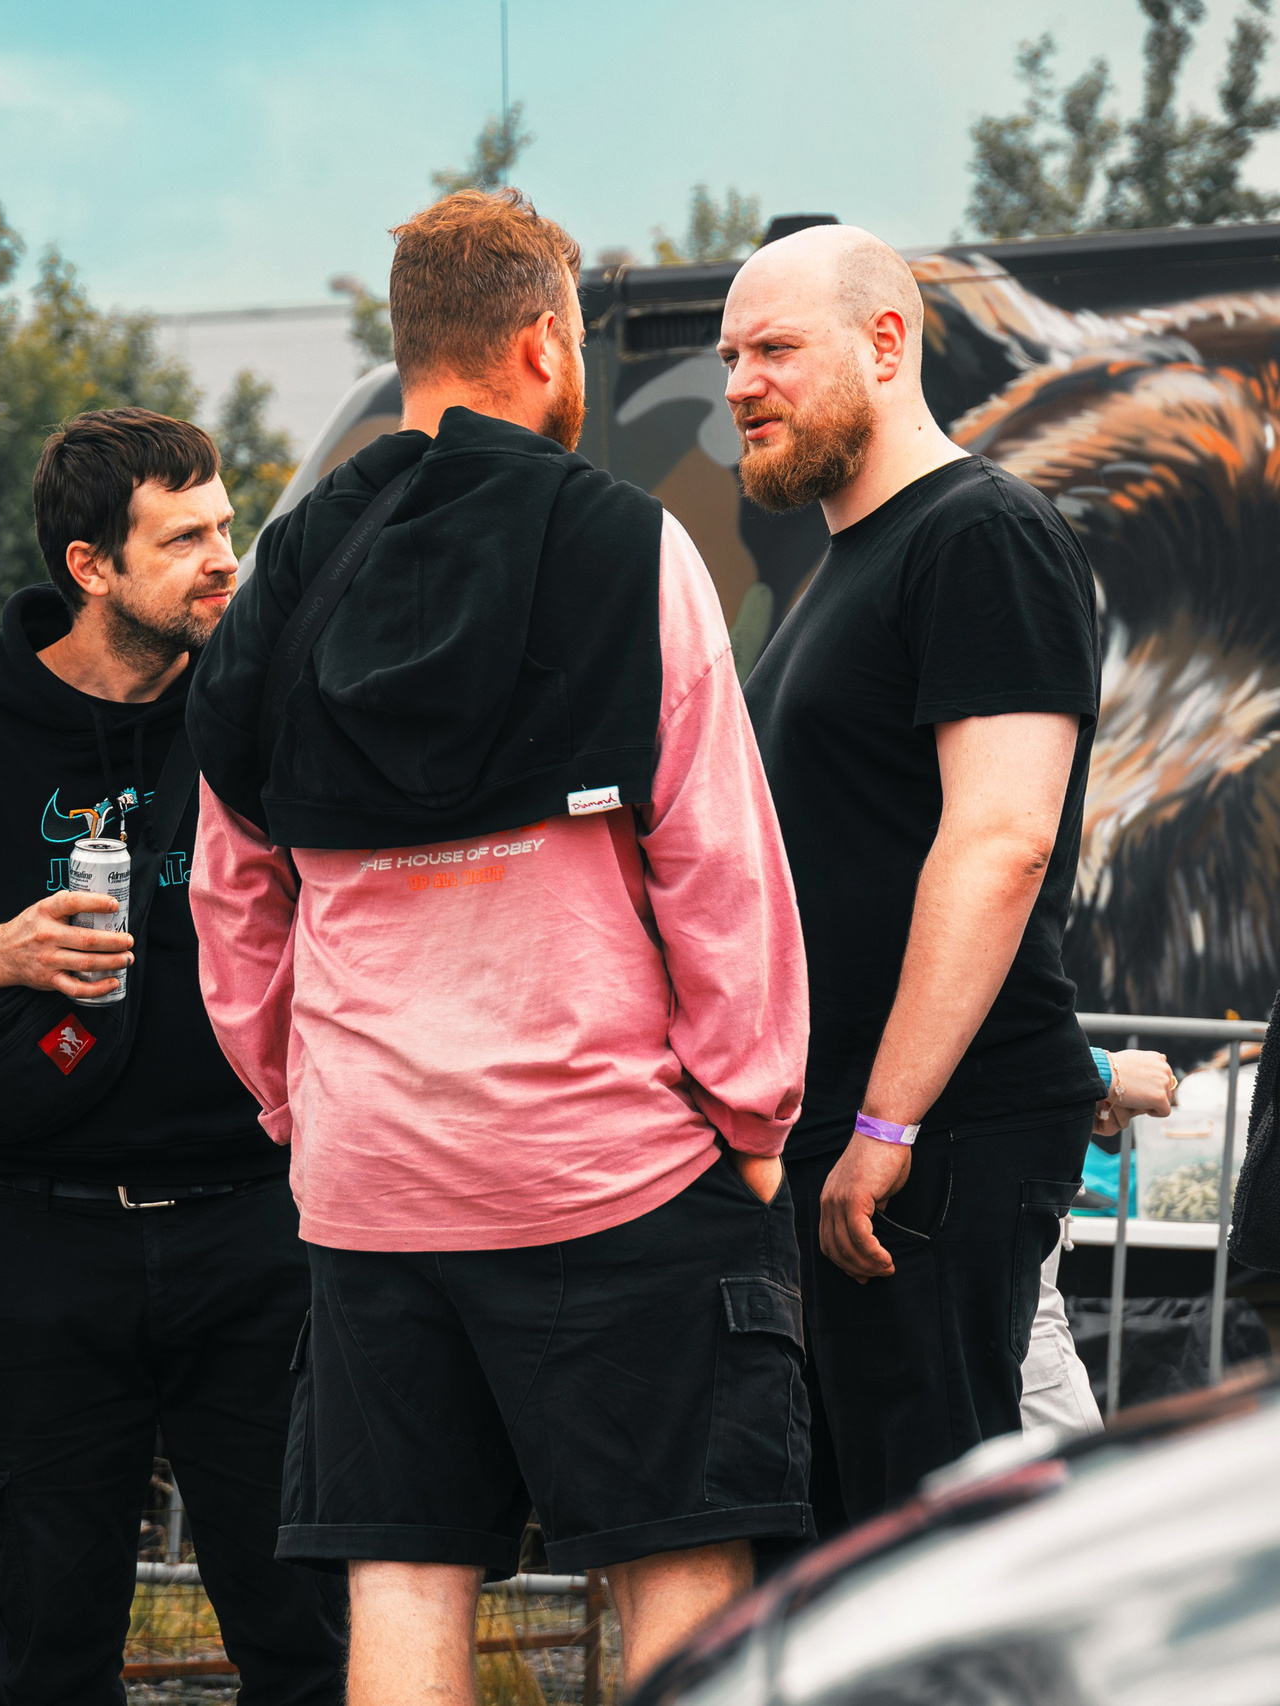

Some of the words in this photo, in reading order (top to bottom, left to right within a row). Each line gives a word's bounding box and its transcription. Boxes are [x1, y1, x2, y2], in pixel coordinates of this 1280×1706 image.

[328, 519, 375, 582] VALENTINO
[284, 595, 325, 661] VALENTINO
[571, 792, 618, 810] Diamond
[359, 858, 393, 872] THE
[396, 850, 465, 868] HOUSE
[466, 847, 489, 861] OF
[493, 838, 546, 857] OBEY
[407, 875, 431, 891] UP
[433, 872, 459, 888] ALL
[461, 865, 506, 885] NIGHT
